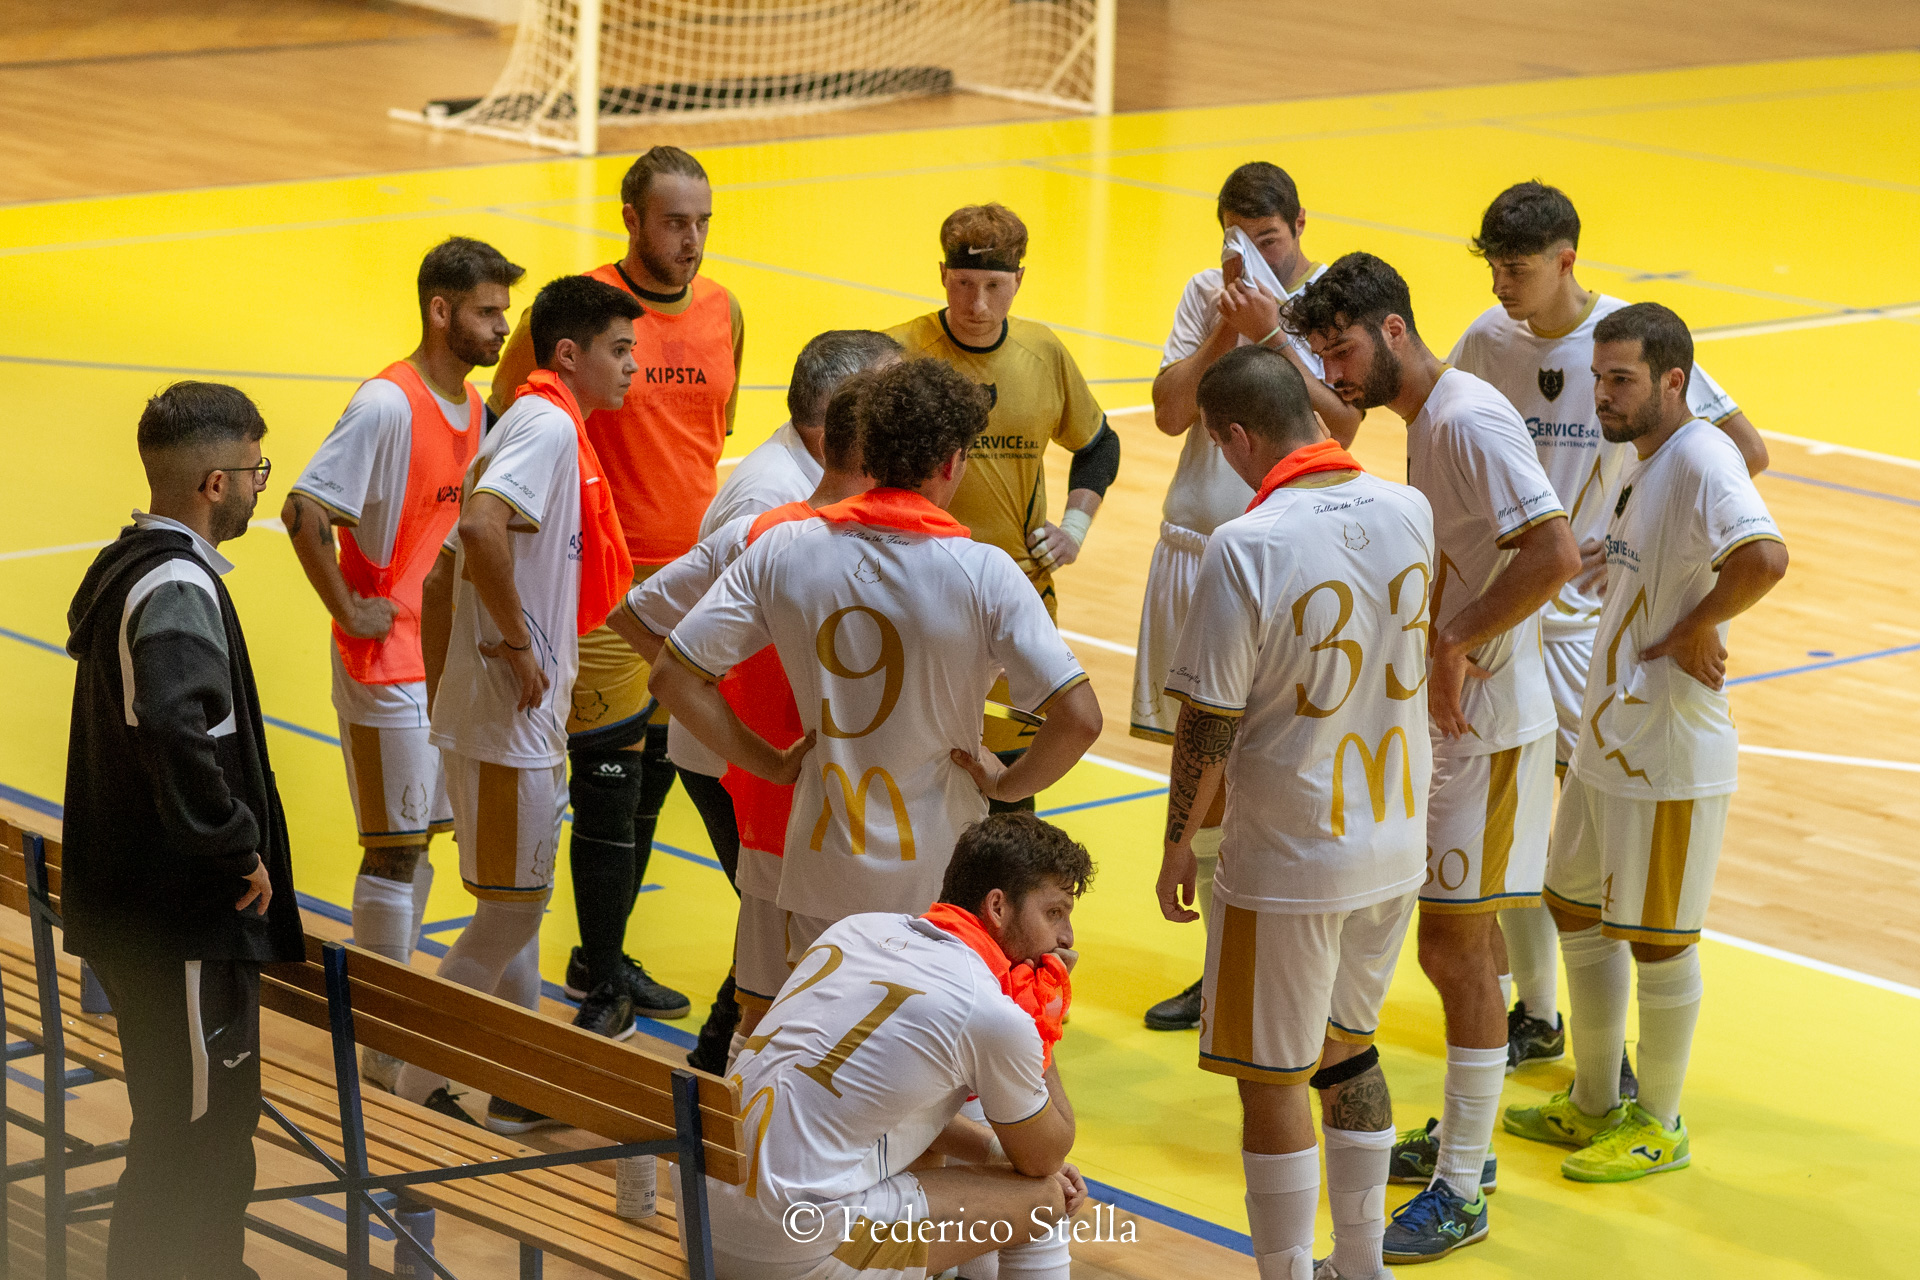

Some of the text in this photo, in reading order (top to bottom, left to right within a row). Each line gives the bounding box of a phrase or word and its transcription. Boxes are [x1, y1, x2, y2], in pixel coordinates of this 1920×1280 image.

[645, 367, 707, 385] KIPSTA
[1525, 416, 1585, 439] SERVICE
[973, 435, 1024, 449] ERVICE
[499, 472, 536, 499] Since 2023
[1312, 496, 1375, 515] Follow the Foxes
[871, 534, 884, 543] the
[885, 534, 910, 546] Foxes
[1291, 561, 1431, 719] 33
[815, 605, 905, 739] 9
[742, 944, 927, 1099] 21
